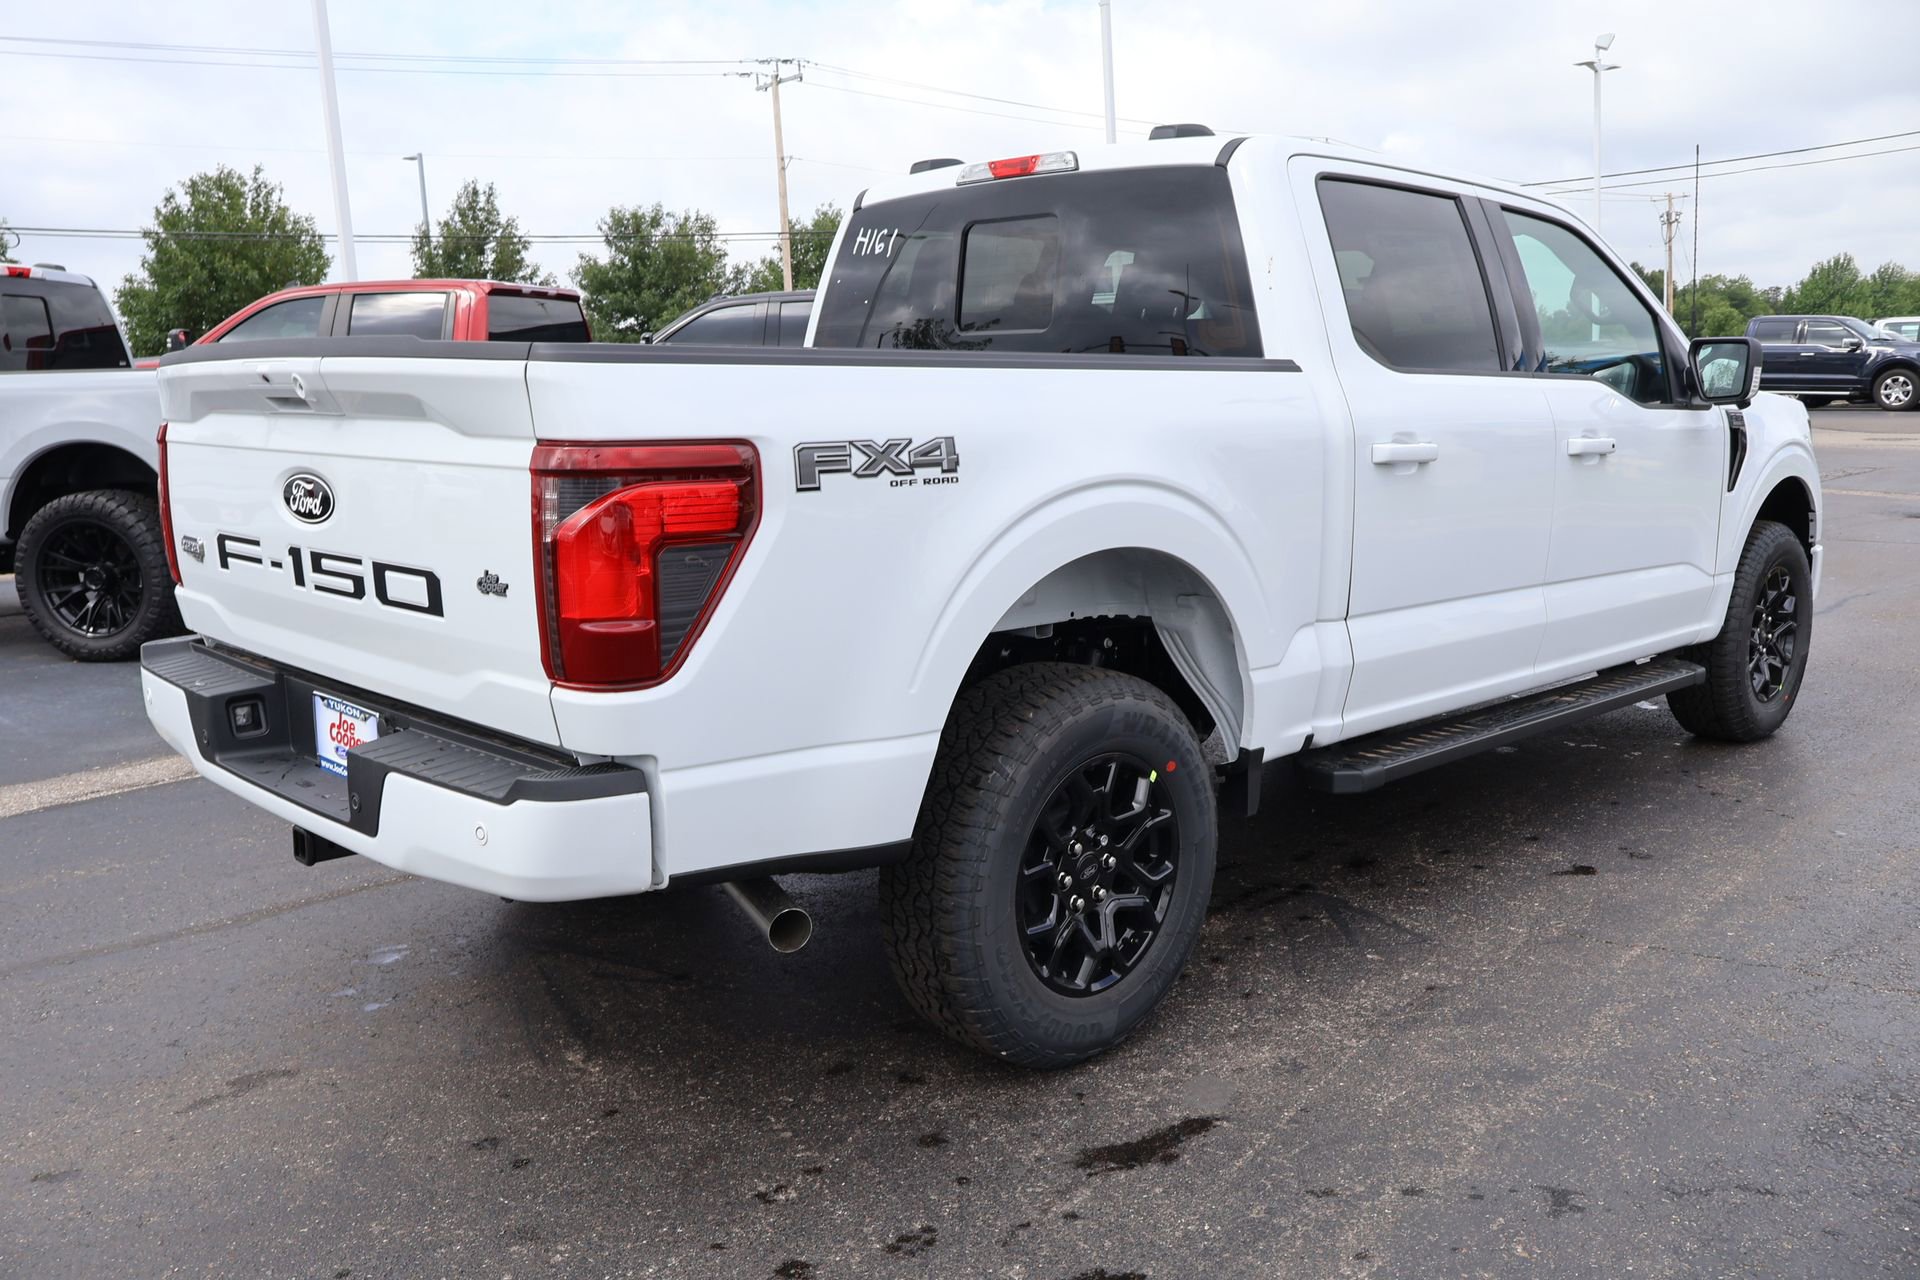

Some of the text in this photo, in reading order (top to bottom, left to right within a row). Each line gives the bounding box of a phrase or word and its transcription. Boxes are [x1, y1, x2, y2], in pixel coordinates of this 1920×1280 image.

[793, 436, 959, 492] FX4
[290, 479, 323, 516] Ford
[890, 476, 959, 488] OFF ROAD
[216, 532, 445, 618] F-150
[328, 700, 360, 718] YUKON
[337, 711, 356, 736] Joe
